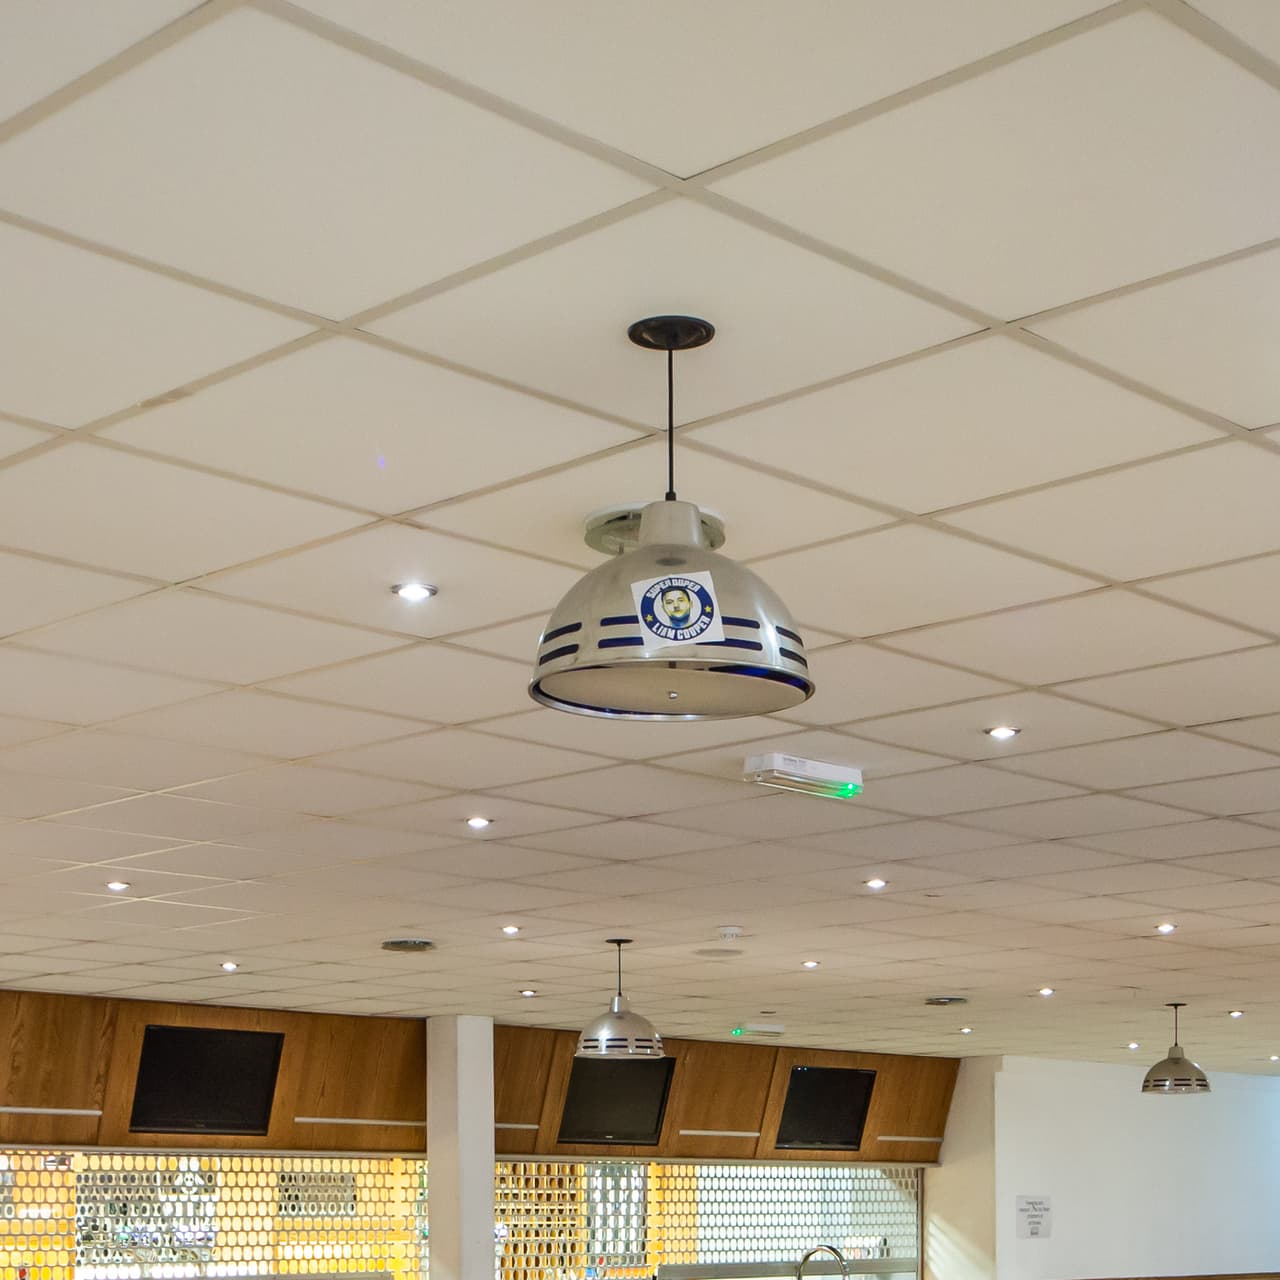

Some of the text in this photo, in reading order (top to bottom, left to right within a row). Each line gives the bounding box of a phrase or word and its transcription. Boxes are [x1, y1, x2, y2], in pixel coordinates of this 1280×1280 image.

[646, 579, 701, 598] SUPER DUPER
[652, 615, 711, 640] LIAM COOPER
